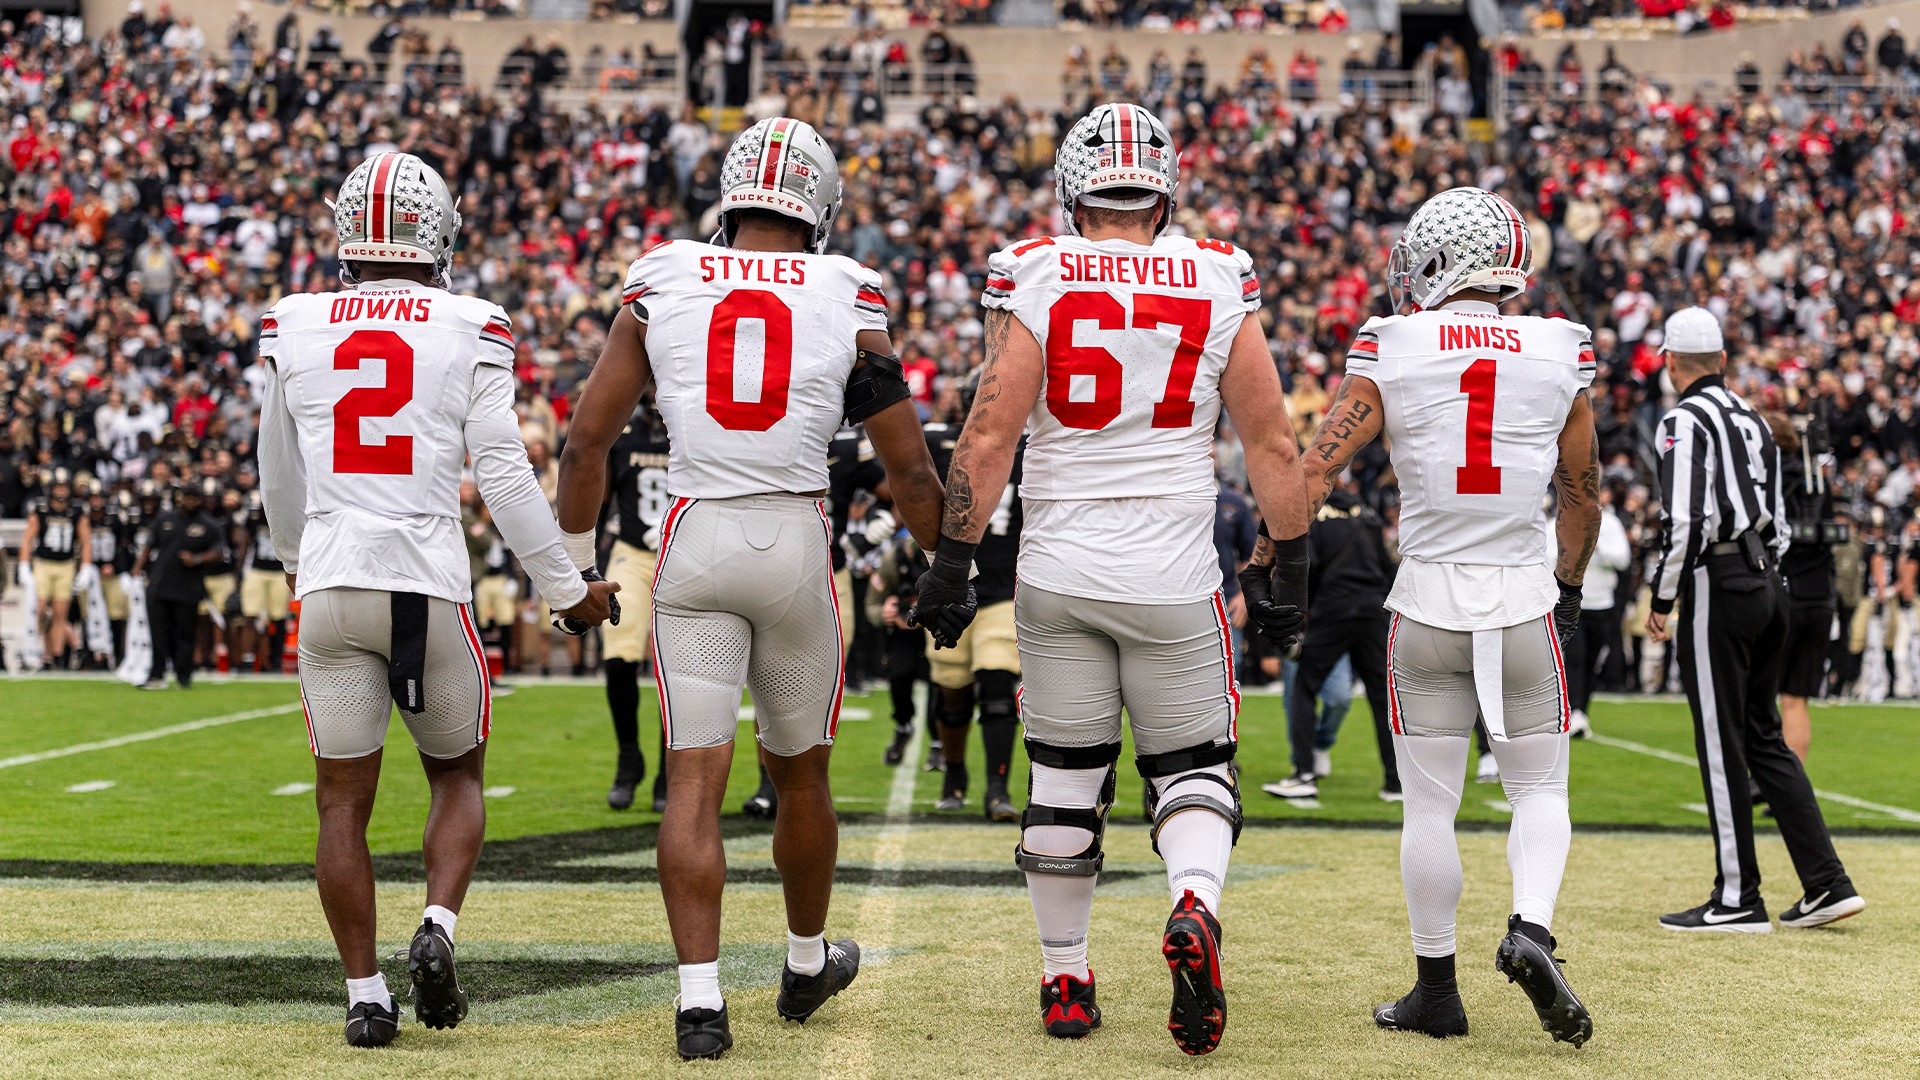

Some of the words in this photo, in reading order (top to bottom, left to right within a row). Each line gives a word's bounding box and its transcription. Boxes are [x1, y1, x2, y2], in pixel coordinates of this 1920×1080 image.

[1100, 158, 1111, 167] 67
[746, 169, 752, 179] 0
[1091, 173, 1162, 185] BUCKEYES
[731, 194, 803, 212] BUCKEYES
[355, 222, 361, 233] 2
[344, 248, 418, 259] BUCKEYES
[700, 256, 806, 285] STYLES
[1060, 252, 1198, 288] SIEREVELD
[359, 288, 411, 296] BUCKEYES
[329, 297, 432, 324] DOWNS
[1453, 311, 1504, 321] BUCKEYES
[1439, 325, 1522, 353] INNISS
[706, 289, 792, 431] 0
[1046, 291, 1212, 430] 67
[333, 330, 414, 474] 2
[1456, 359, 1500, 494] 1
[1730, 412, 1768, 484] R
[1038, 862, 1077, 870] DONJOY
